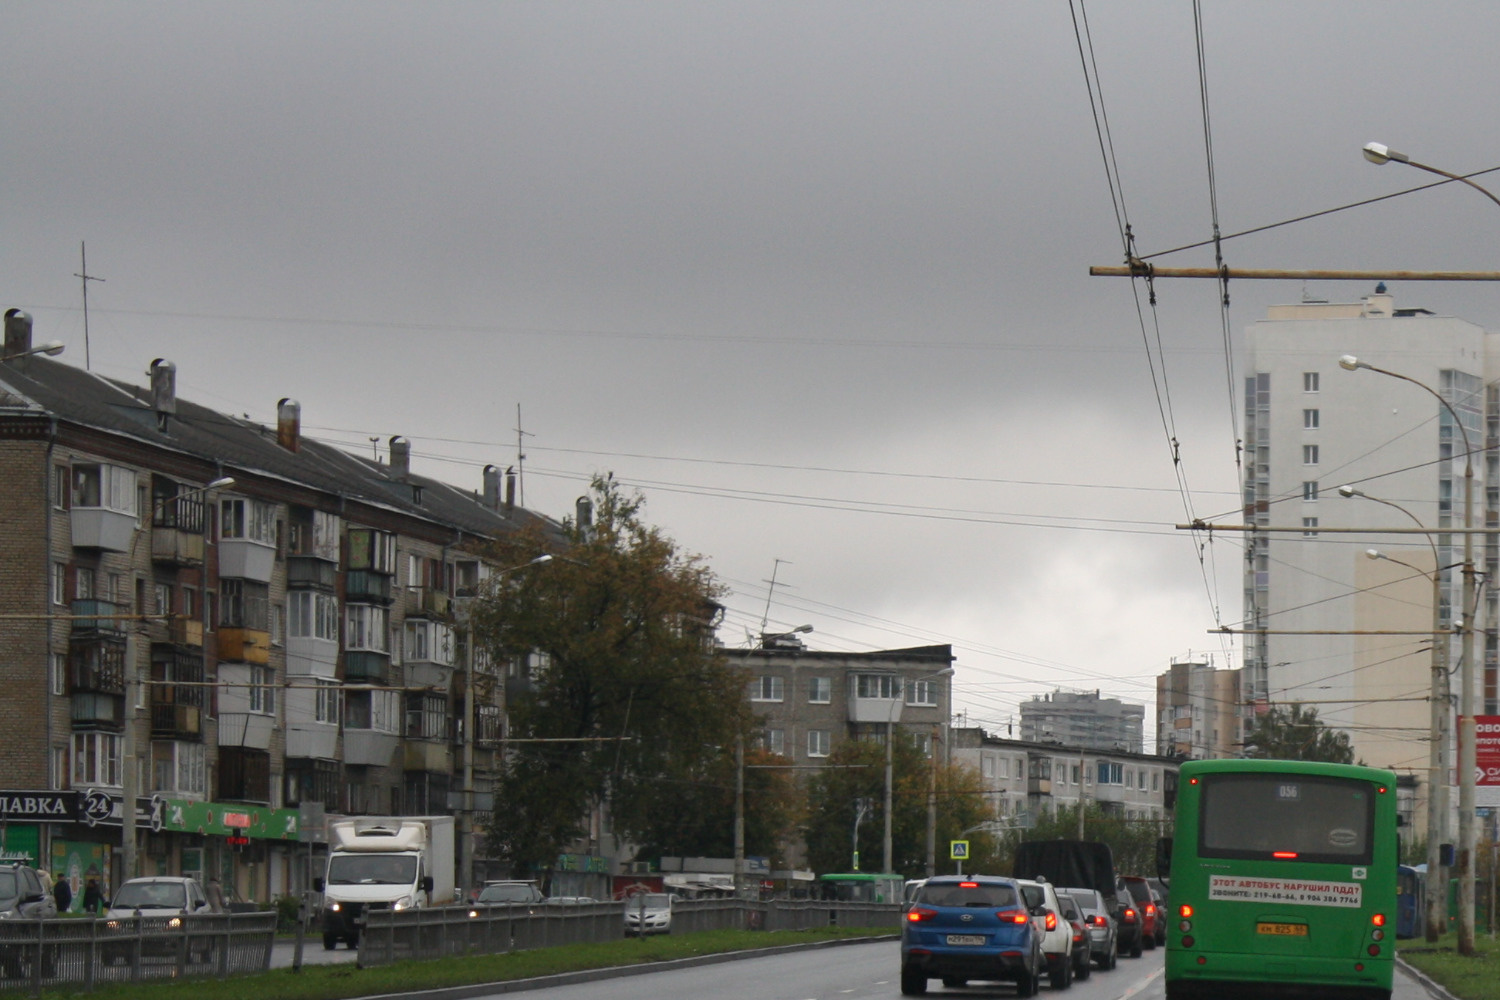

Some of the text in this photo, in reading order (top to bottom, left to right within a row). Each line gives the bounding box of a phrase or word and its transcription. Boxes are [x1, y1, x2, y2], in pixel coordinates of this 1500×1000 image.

[1280, 785, 1297, 798] 056
[88, 799, 108, 814] 24
[1213, 879, 1360, 895] ЭТОТ АВТОБУС НАРУШИЛ ПДД?
